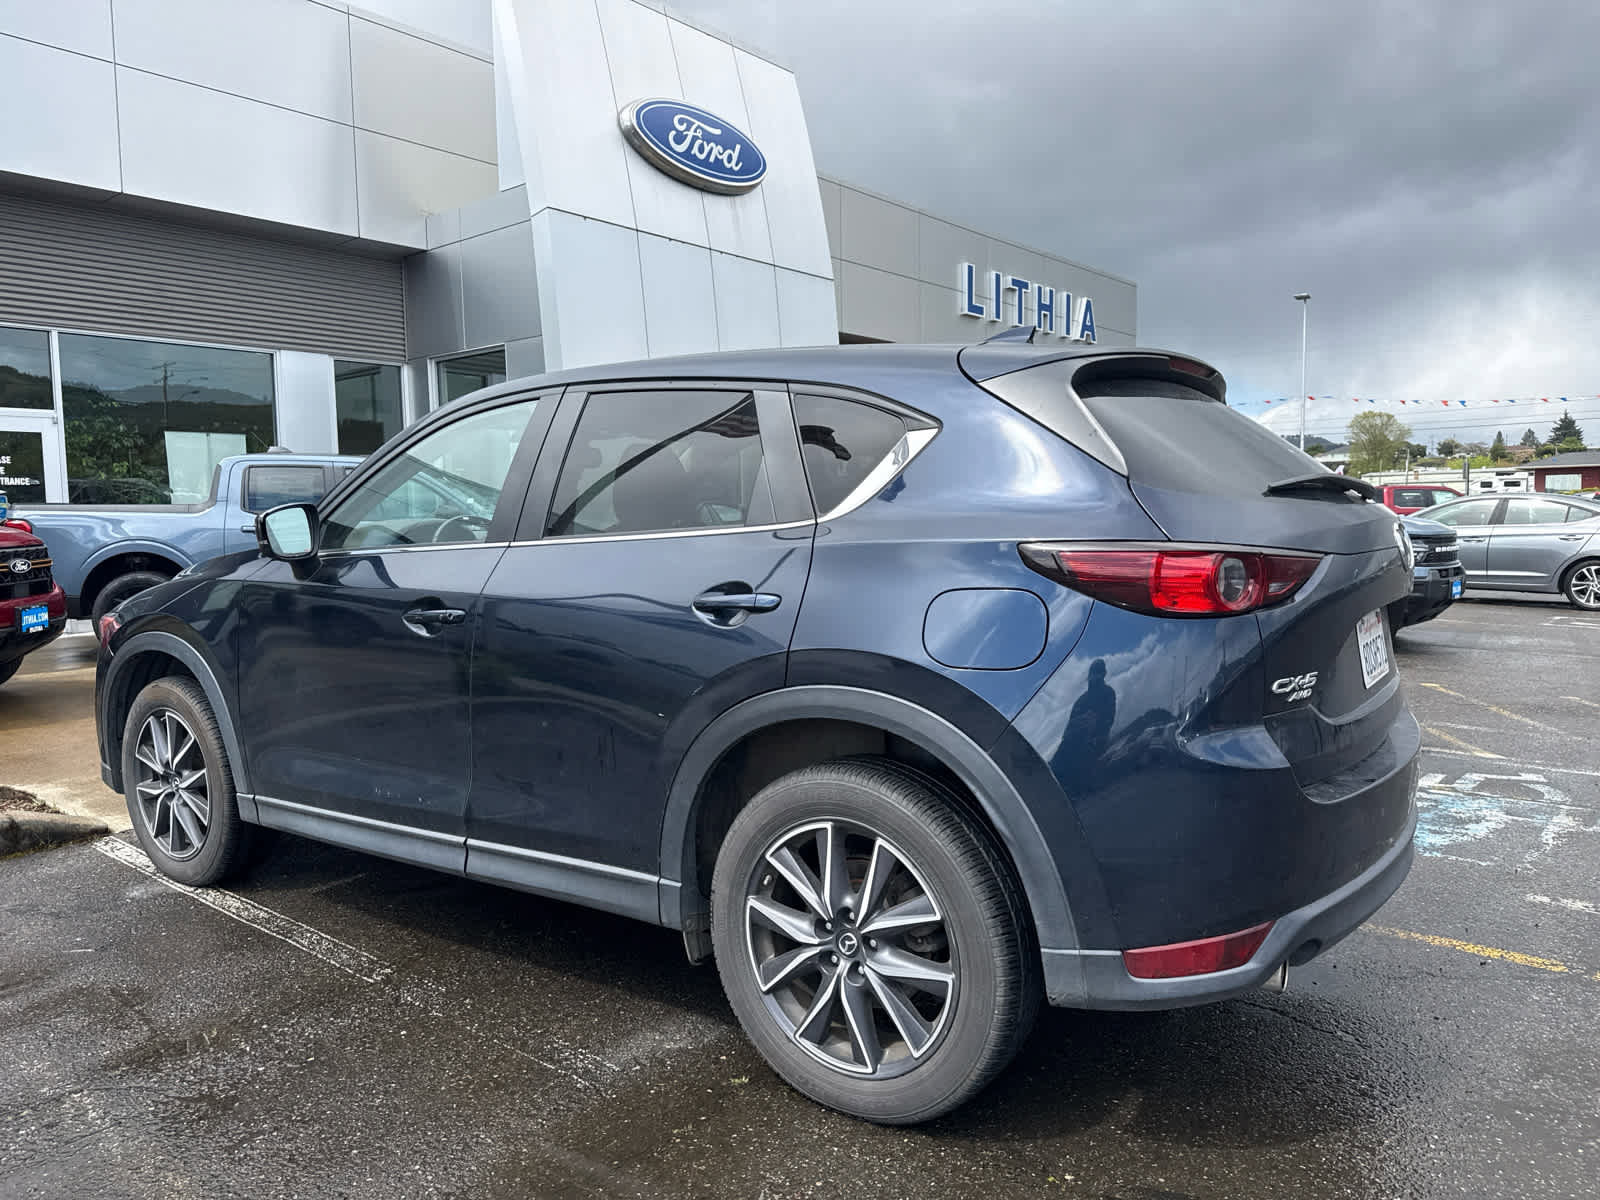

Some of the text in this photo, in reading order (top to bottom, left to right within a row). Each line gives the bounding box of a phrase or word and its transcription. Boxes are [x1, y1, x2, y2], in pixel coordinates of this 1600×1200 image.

[668, 114, 743, 171] Ford
[959, 262, 1097, 344] LITHIA
[0, 456, 12, 464] SE
[1271, 671, 1319, 694] CX-5
[1287, 687, 1312, 702] AWD
